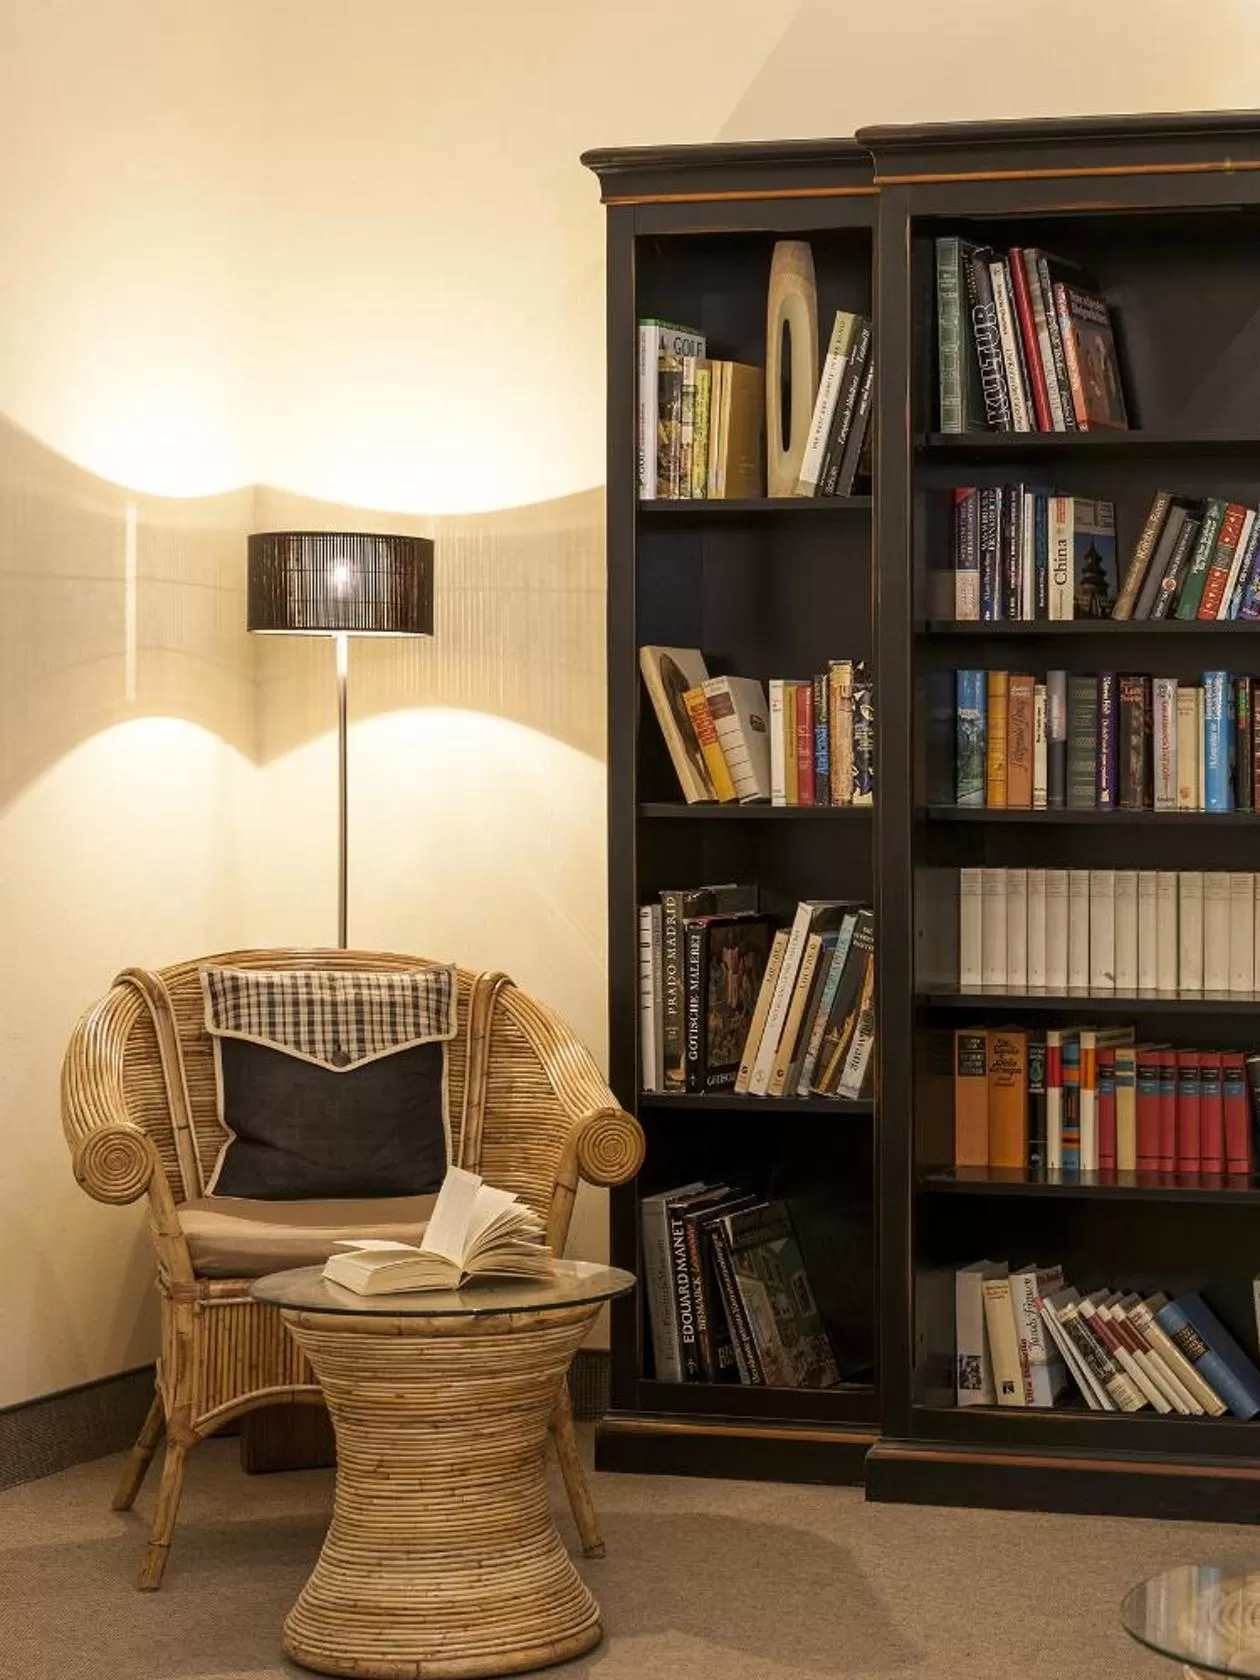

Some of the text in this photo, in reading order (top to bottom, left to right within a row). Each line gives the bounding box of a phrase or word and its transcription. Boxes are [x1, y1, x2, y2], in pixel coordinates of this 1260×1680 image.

[674, 336, 703, 356] GOLF
[972, 303, 1009, 425] KULTUR
[1054, 539, 1068, 586] China
[665, 895, 678, 1015] PRADO MADRID
[688, 934, 700, 1061] GOTISCHE MALEREI
[671, 1218, 695, 1343] EDOUARD MANET
